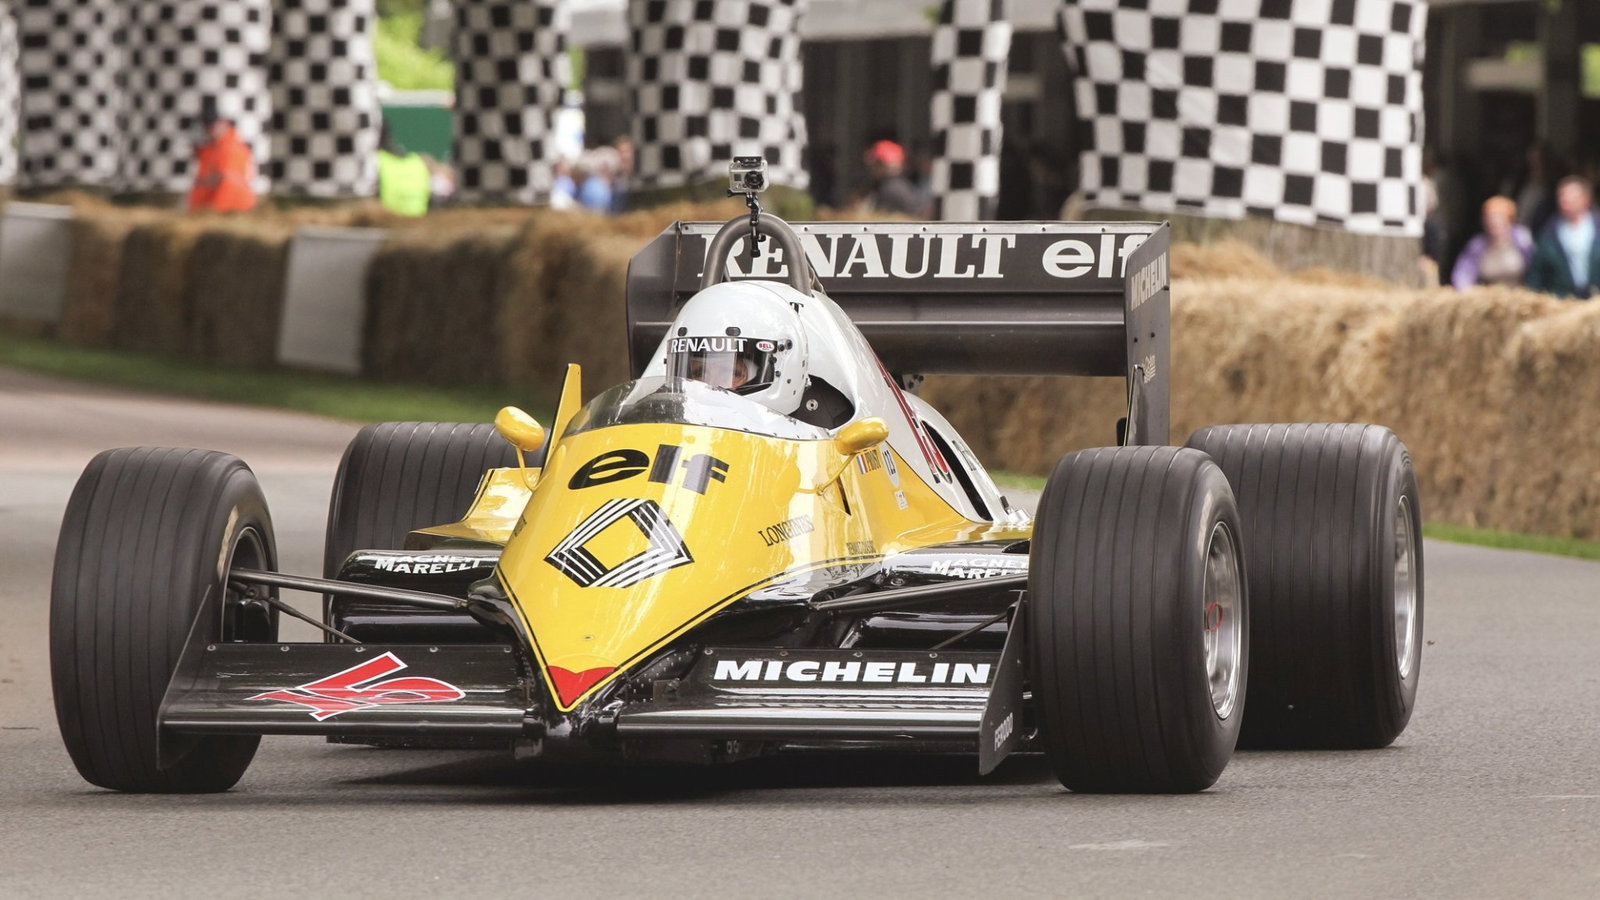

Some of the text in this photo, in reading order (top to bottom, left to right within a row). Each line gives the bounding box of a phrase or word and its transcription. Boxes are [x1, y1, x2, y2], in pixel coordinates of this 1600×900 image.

[697, 234, 1148, 278] RENAULT elf
[1131, 252, 1167, 311] MICHELIN
[670, 338, 748, 353] RENAULT
[568, 444, 729, 495] elf
[758, 514, 815, 546] LONGINES
[714, 660, 991, 684] MICHELIN
